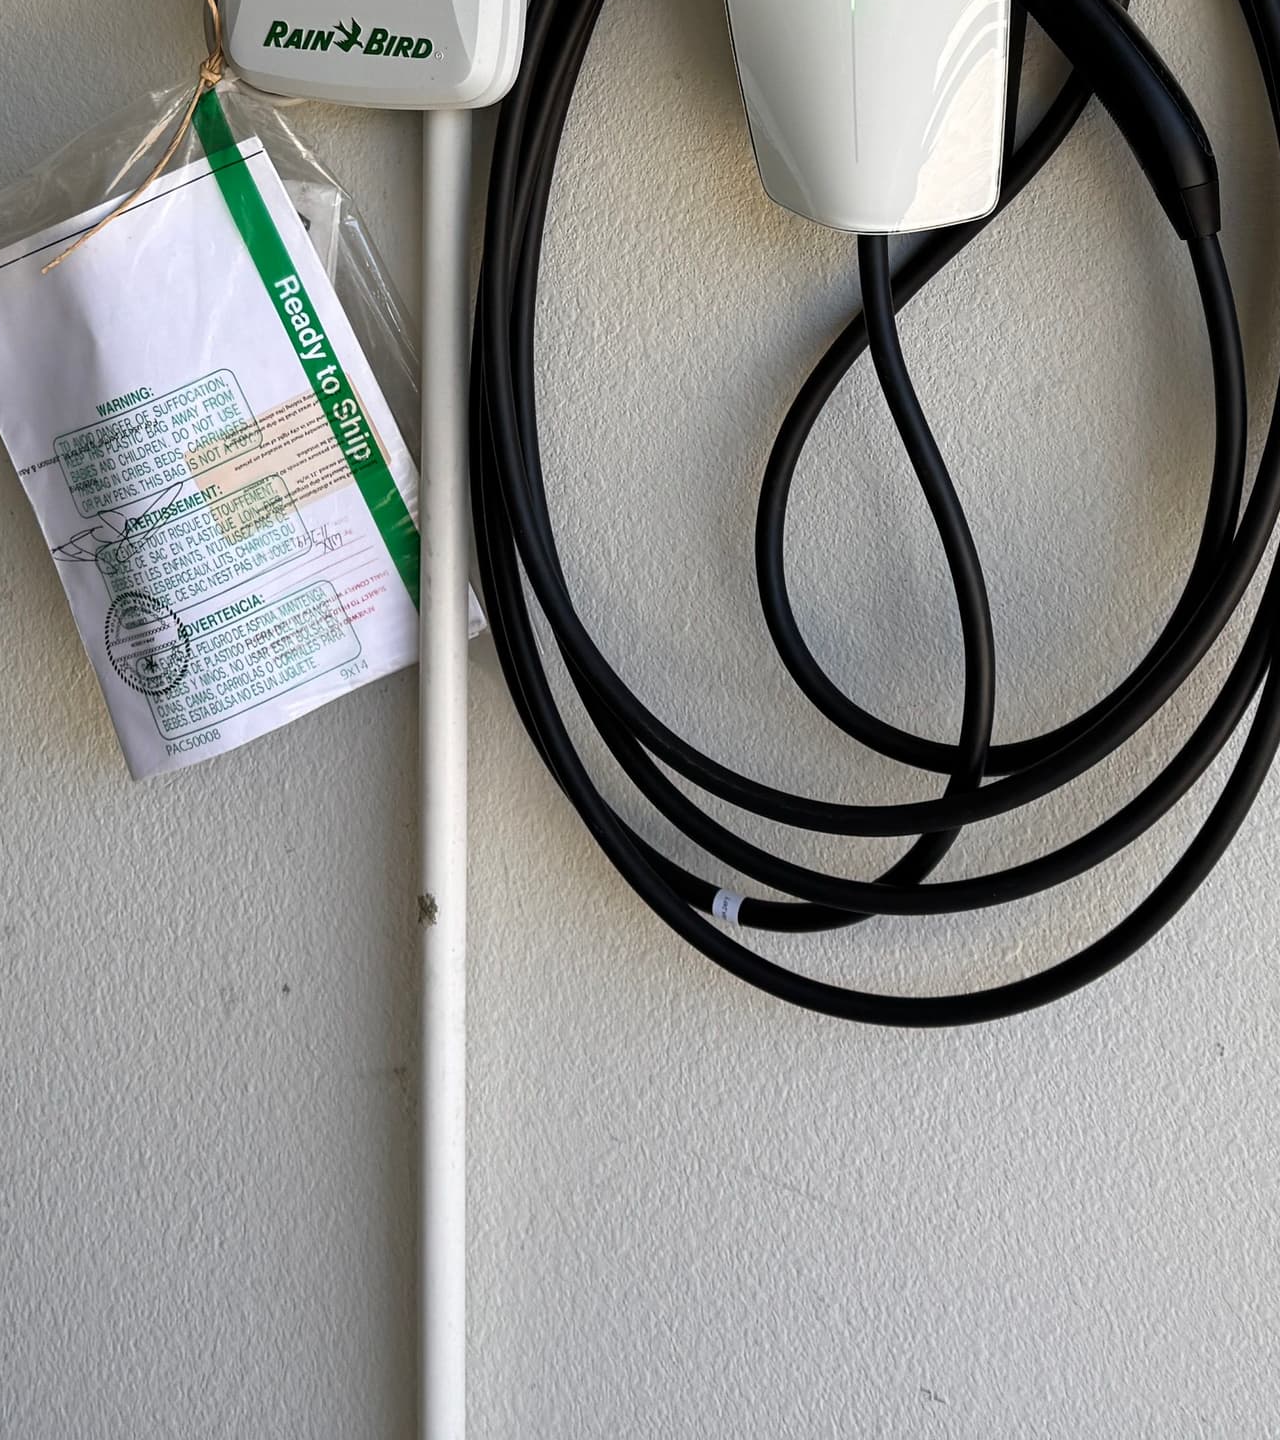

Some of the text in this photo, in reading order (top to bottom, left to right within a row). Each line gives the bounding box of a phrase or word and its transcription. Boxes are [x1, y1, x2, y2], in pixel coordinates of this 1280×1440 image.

[263, 20, 433, 59] RAIN BIRD
[274, 274, 372, 461] Ready to Ship
[95, 416, 132, 441] DANGER
[134, 410, 150, 425] OF
[151, 374, 229, 417] SUFFOCATION,
[96, 385, 153, 417] WARNING:
[104, 430, 143, 455] PLASTIC
[144, 420, 168, 438] BAG
[170, 405, 200, 426] AWAY
[202, 389, 234, 411] FROM
[111, 473, 121, 485] IN
[185, 417, 249, 453] CARRIAGES
[117, 436, 170, 466] CHILDREN.
[171, 426, 190, 443] DO
[192, 415, 215, 434] NOT
[217, 403, 241, 422] USE
[112, 482, 139, 502] PENS.
[139, 473, 163, 491] THIS
[162, 463, 186, 481] BAG
[186, 457, 198, 471] IS
[198, 447, 221, 465] NOT
[222, 442, 231, 454] A
[125, 483, 223, 534] AVERTISSEMENT:
[167, 516, 202, 540] RISQUE
[133, 572, 144, 585] ET
[144, 566, 161, 581] LES
[162, 548, 205, 574] ENFANTS.
[254, 515, 274, 532] PAS
[134, 555, 147, 569] CE
[148, 546, 167, 563] SAC
[169, 540, 183, 555] EN
[185, 517, 236, 548] PLASTIQUE
[238, 505, 260, 523] LOIN
[149, 521, 296, 595] LES BERCEAUX, LITS, CHARIOTS OU
[174, 587, 188, 602] CE
[187, 579, 207, 596] SAC
[233, 558, 253, 575] PAS
[252, 551, 268, 566] UN
[175, 593, 266, 640] ADVERTENCIA:
[195, 630, 234, 655] PELIGRO
[231, 624, 245, 640] DE
[276, 586, 326, 617] MANTENGA
[184, 686, 217, 709] CAMAS,
[214, 665, 265, 695] CARRIOLAS
[264, 660, 274, 673] O
[272, 638, 322, 669] CORRALES
[320, 626, 345, 646] PARA
[190, 659, 204, 674] DE
[203, 642, 245, 669] PLASTICO
[244, 627, 275, 650] FUERA
[190, 677, 198, 689] Y
[228, 658, 244, 673] NO
[244, 646, 270, 666] USAR
[339, 659, 369, 680] 9x14
[188, 705, 210, 722] ESTA
[208, 693, 238, 714] BOLSA
[236, 687, 252, 703] NO
[250, 681, 264, 696] ES
[263, 675, 278, 690] UN
[166, 725, 221, 758] PAC50008
